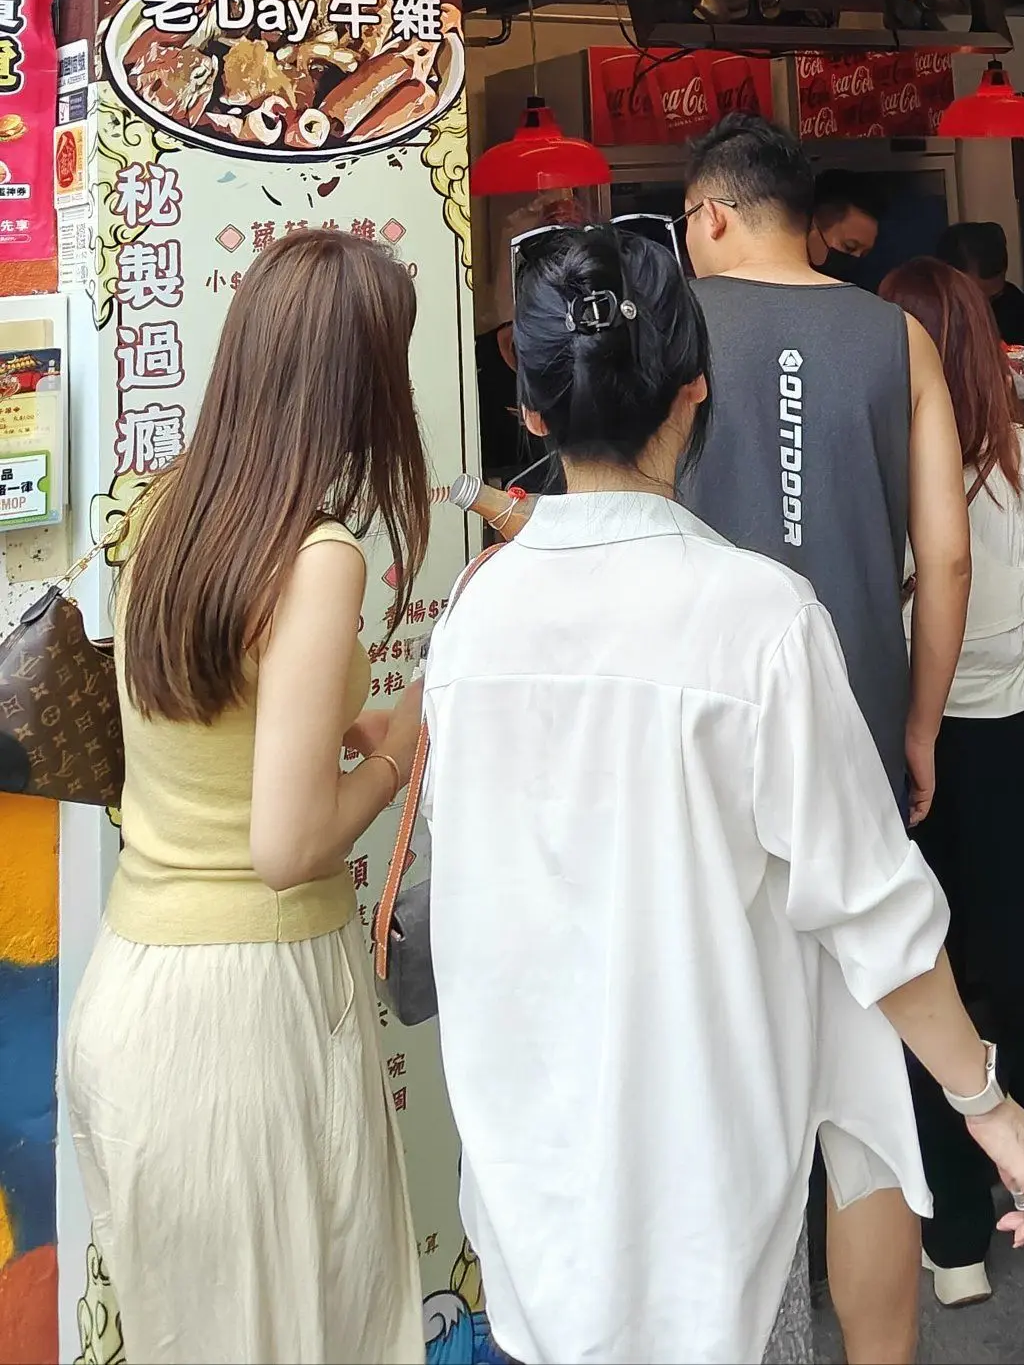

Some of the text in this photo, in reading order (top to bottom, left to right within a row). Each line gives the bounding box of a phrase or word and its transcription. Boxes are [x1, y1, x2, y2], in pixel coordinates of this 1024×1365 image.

[114, 161, 185, 476] 秘製過癮
[780, 374, 802, 547] OUTDOOR
